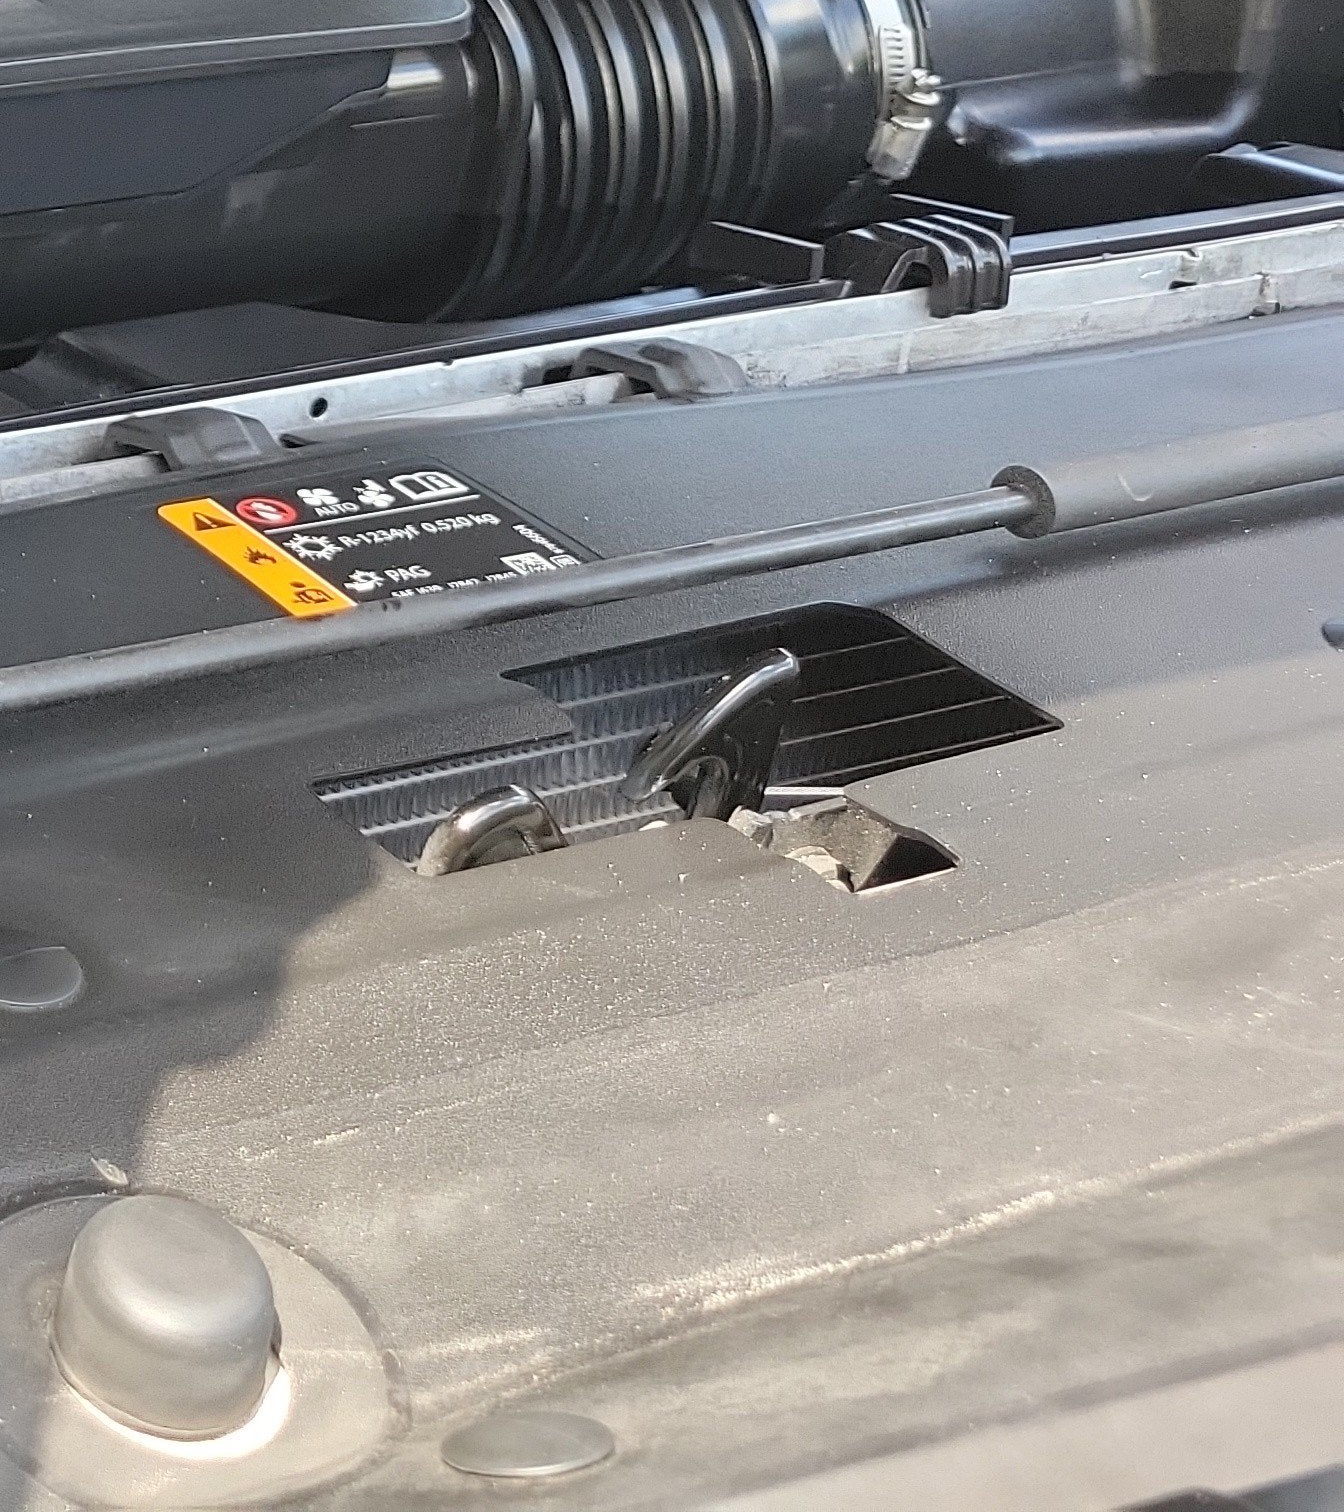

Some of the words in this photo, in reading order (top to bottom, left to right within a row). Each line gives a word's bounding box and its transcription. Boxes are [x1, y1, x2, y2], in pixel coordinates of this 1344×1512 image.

[313, 502, 360, 518] AUTO
[337, 524, 420, 548] R-1234yf
[466, 513, 502, 526] kg
[384, 565, 432, 583] PAG
